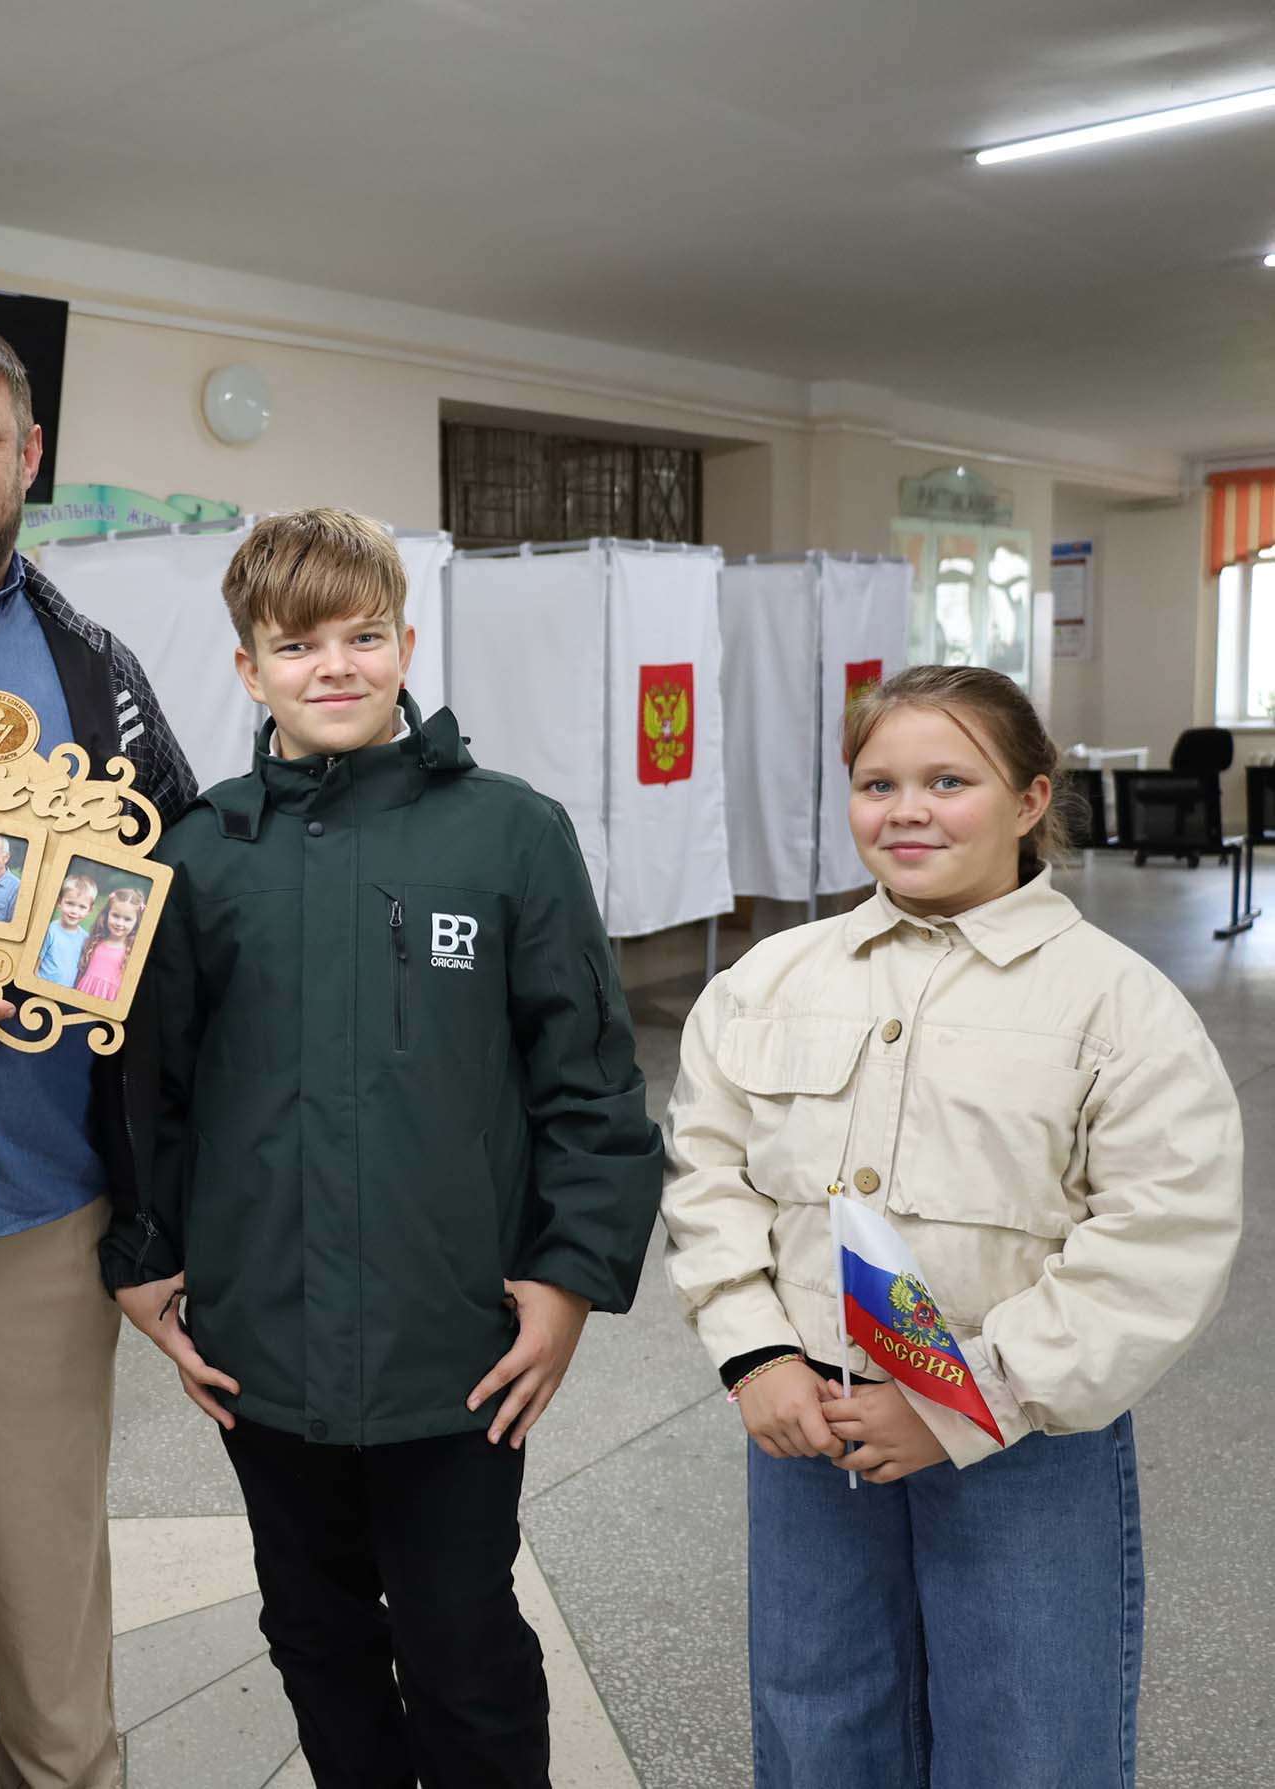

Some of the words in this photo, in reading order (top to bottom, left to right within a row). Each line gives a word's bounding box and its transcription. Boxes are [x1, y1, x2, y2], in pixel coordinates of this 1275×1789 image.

[25, 504, 117, 529] ШКОЛЬНАЯ
[431, 912, 478, 955] BR
[430, 956, 474, 970] ORIGINAL
[874, 1328, 965, 1387] РОССИЯ
